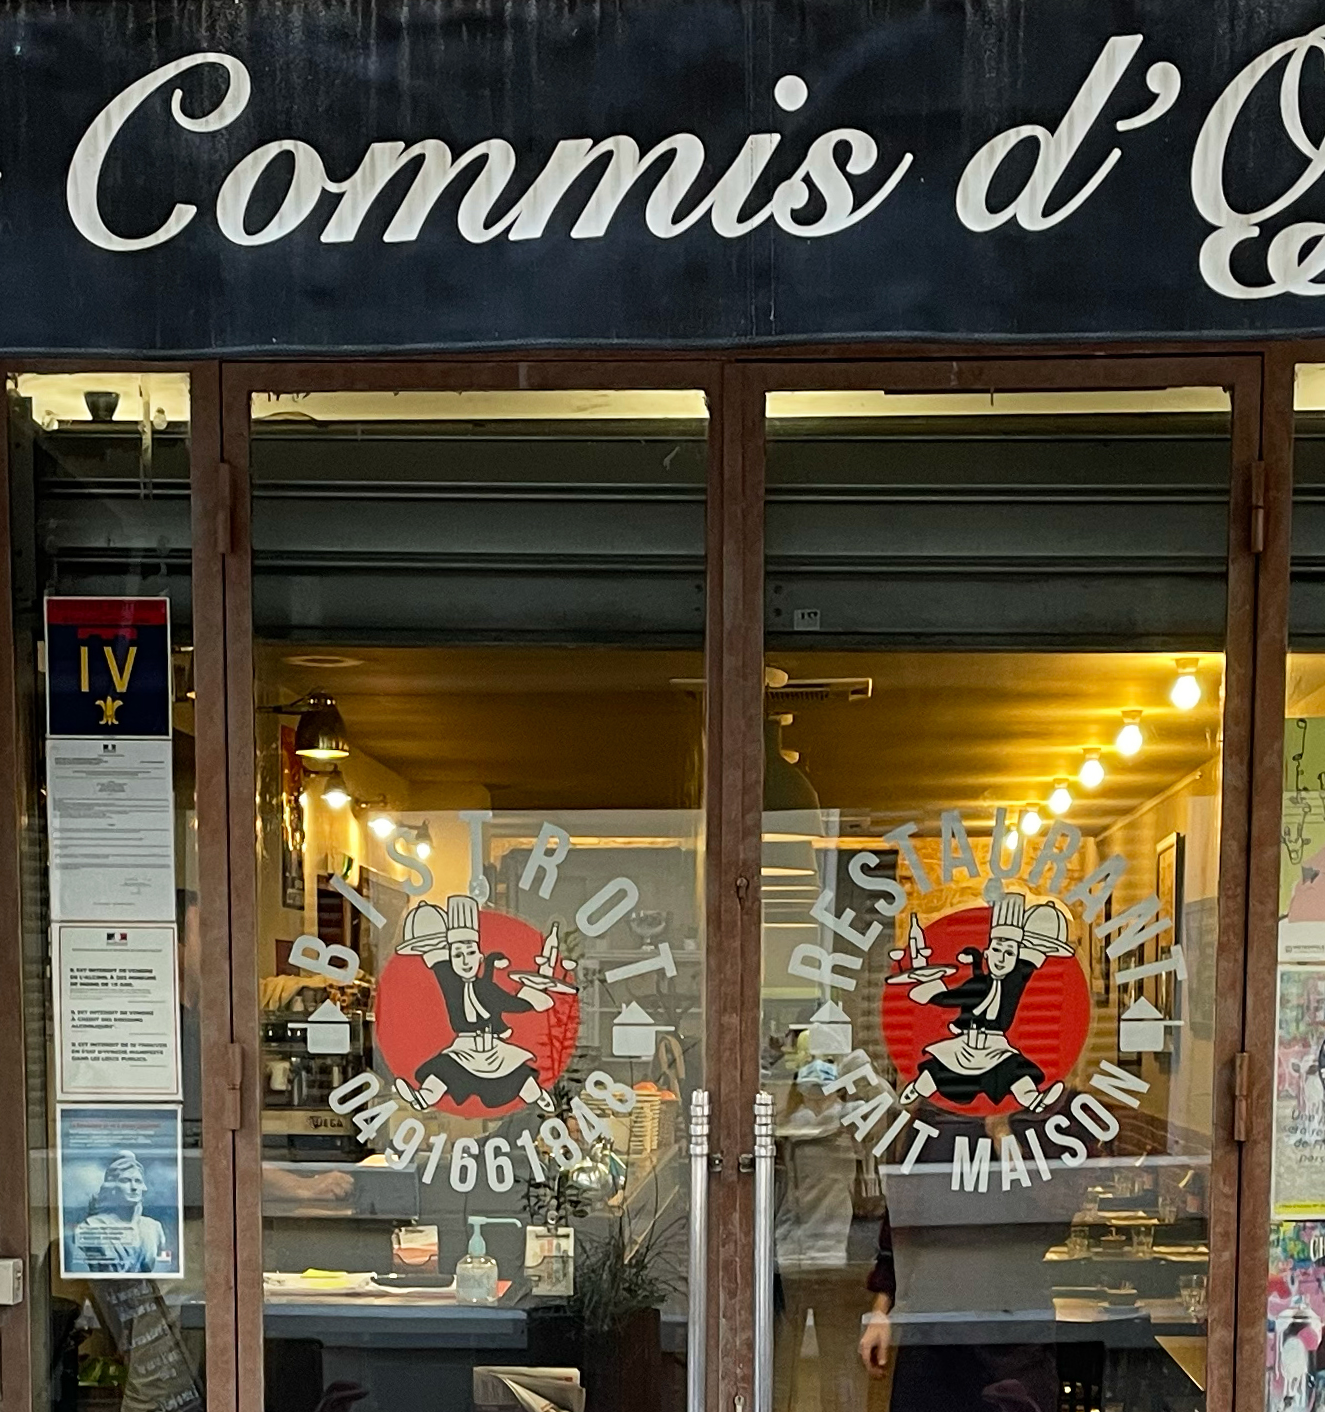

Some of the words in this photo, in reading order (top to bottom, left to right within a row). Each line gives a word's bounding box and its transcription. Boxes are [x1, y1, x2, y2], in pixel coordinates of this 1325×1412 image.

[66, 52, 912, 252] Commis
[80, 646, 137, 692] IV
[288, 811, 677, 985] BISTROT
[788, 808, 1188, 991] RESTAURANT
[328, 1071, 637, 1193] 0491661848
[823, 1065, 939, 1175] FAIT
[950, 1061, 1150, 1192] MAISON
